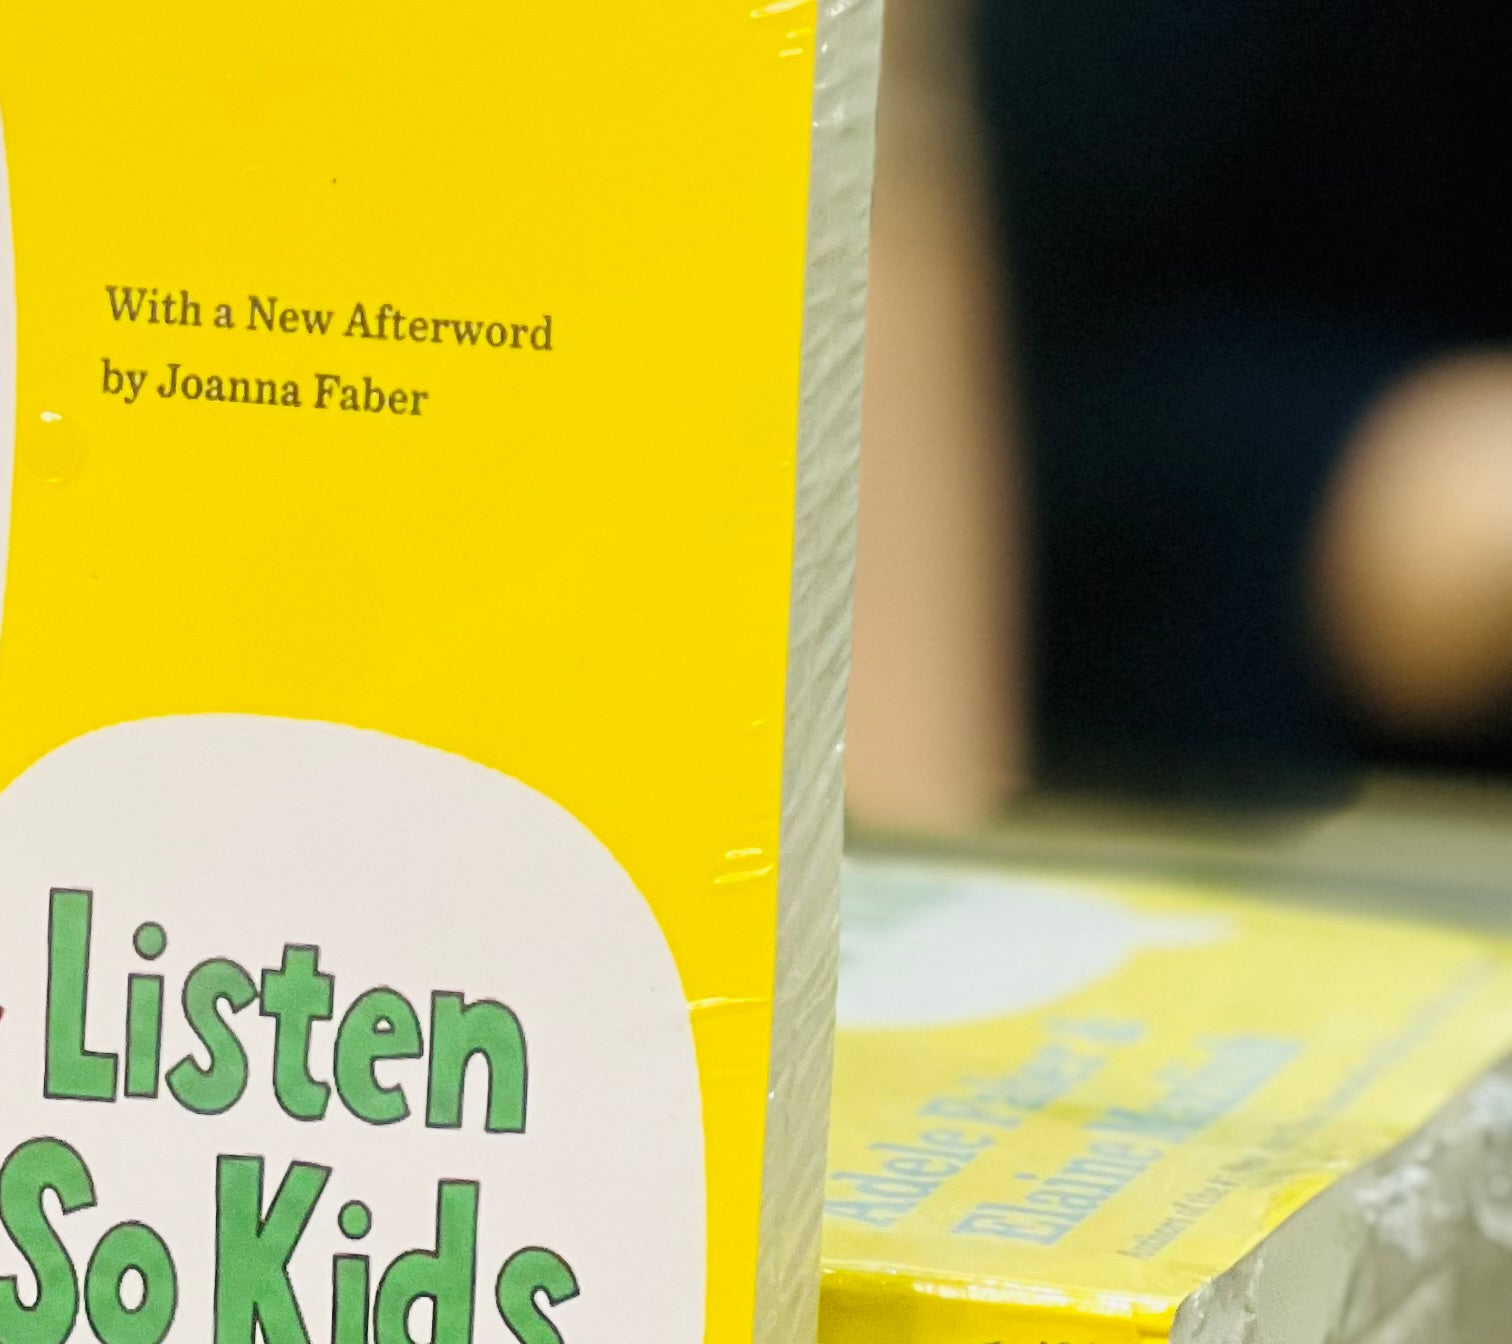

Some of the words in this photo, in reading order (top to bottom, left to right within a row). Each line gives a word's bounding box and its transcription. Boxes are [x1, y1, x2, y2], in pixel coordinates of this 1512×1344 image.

[105, 284, 201, 328] With
[213, 305, 235, 330] a
[247, 294, 333, 336] New
[343, 302, 554, 351] Afterword
[101, 357, 147, 405] by
[157, 362, 301, 409] Joanna
[313, 373, 429, 417] Faber
[42, 886, 529, 1134] Listen
